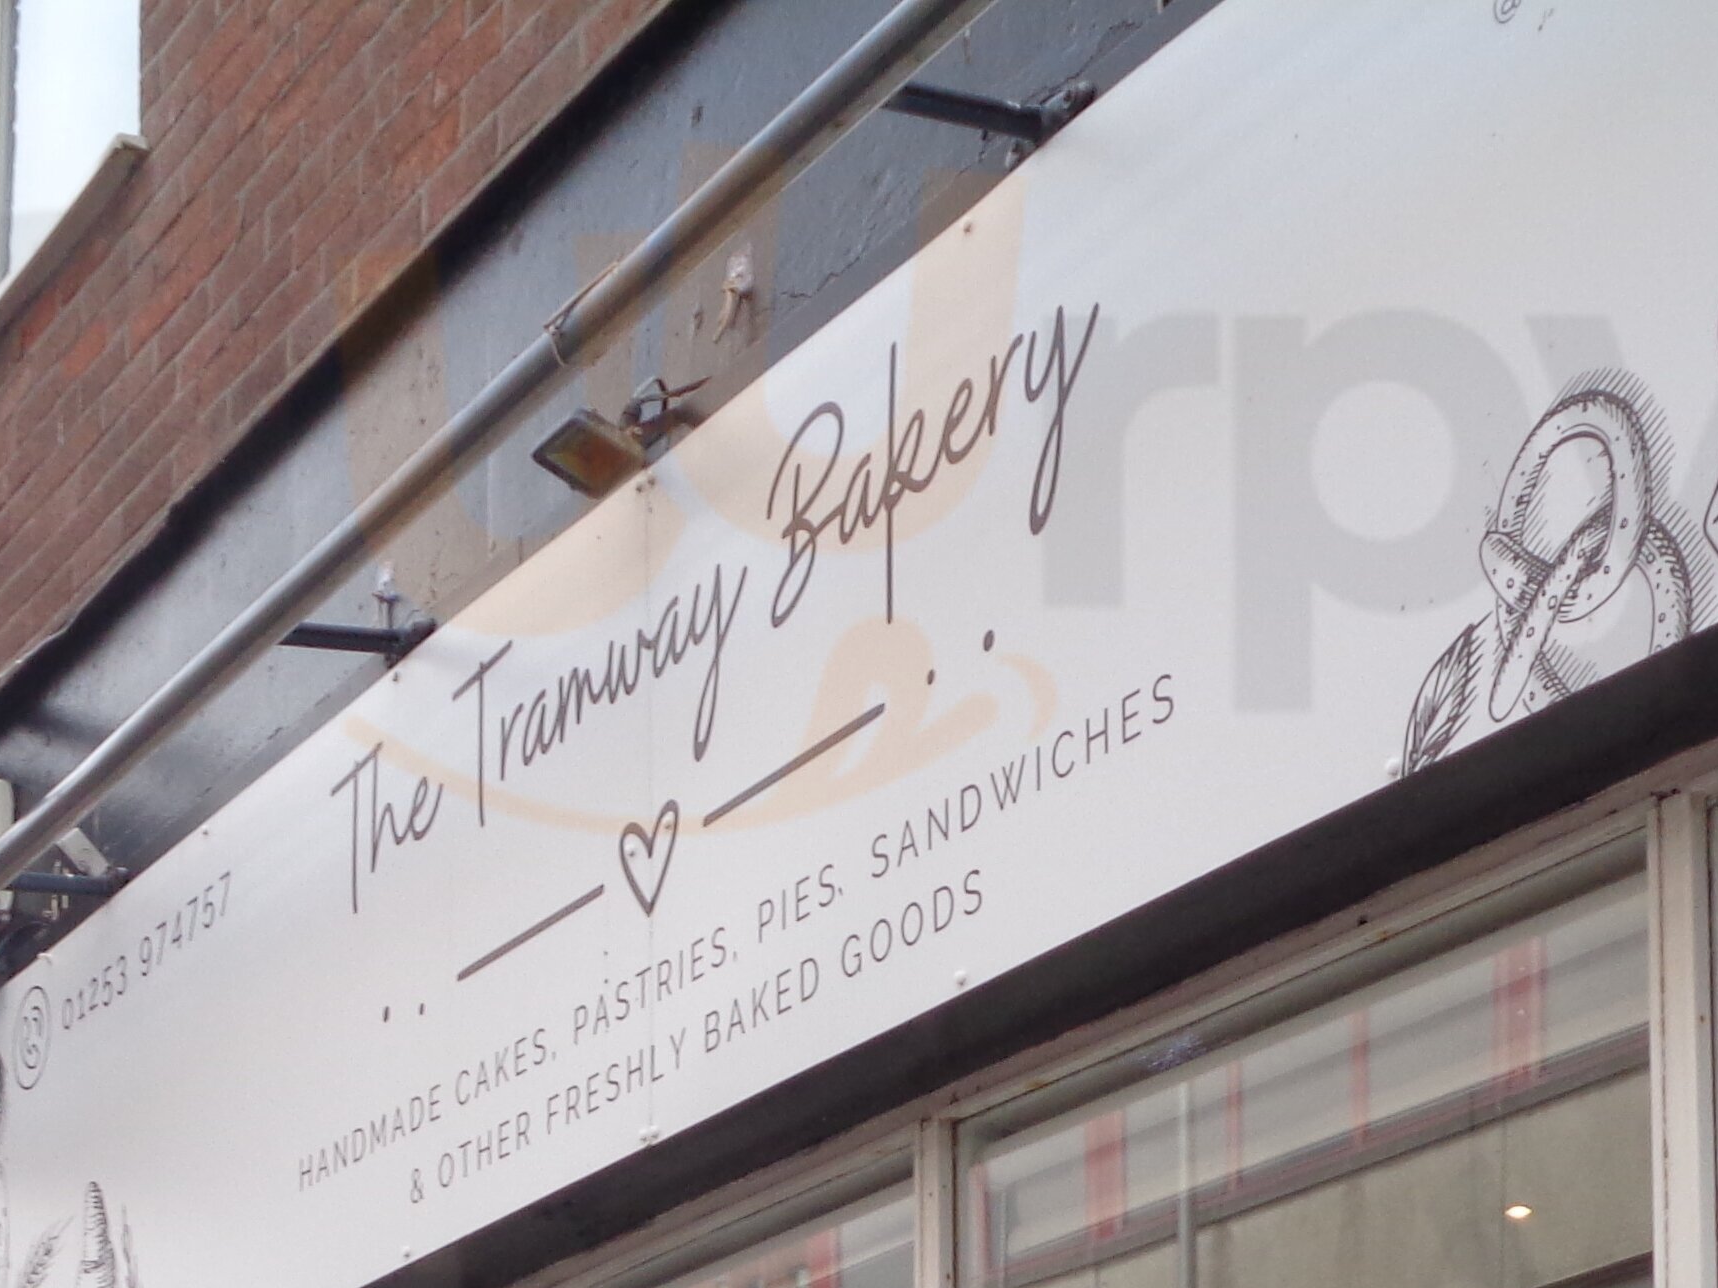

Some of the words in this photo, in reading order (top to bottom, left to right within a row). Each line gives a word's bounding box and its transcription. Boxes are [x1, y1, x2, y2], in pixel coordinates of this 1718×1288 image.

[332, 744, 443, 914] The
[453, 564, 748, 827] Tramway
[765, 302, 1099, 627] Bakery
[62, 956, 127, 1030] 01253
[139, 870, 231, 976] 974757
[299, 1084, 441, 1191] HANDMADE
[455, 1028, 557, 1106] CAKES,
[871, 673, 1176, 879] SANDWICHES
[409, 1167, 425, 1205] &
[437, 1110, 531, 1189] OTHER
[545, 1033, 687, 1135] FRESHLY
[703, 957, 820, 1055] BAKED
[840, 869, 984, 977] GOODS
